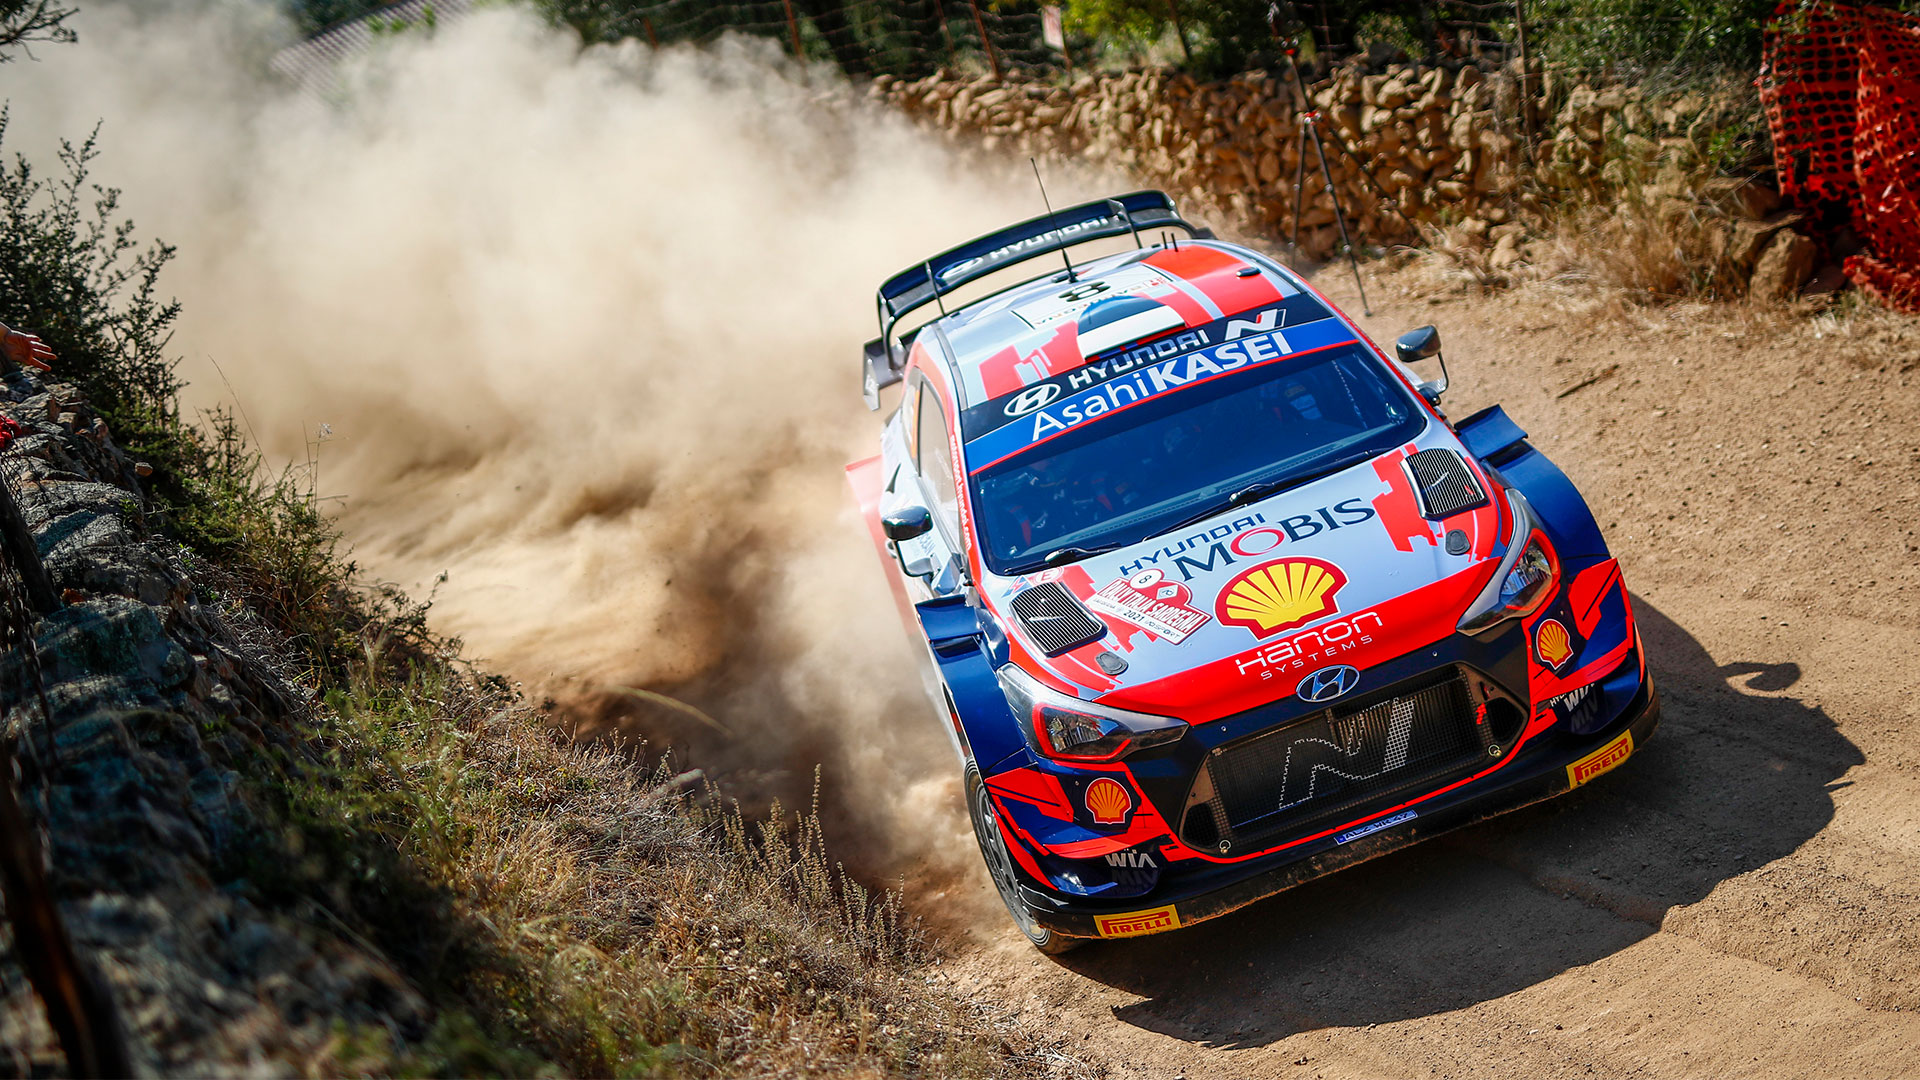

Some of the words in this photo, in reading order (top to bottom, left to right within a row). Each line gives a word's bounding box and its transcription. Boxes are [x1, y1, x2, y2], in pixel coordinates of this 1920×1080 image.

[989, 215, 1109, 259] HYUNDAI
[1058, 281, 1111, 302] 8
[1068, 329, 1211, 390] HYUNDAI
[1119, 513, 1267, 576] HYUNDAI
[1172, 498, 1376, 582] MOBIS
[1139, 574, 1152, 584] 8
[1100, 580, 1134, 603] RALLY
[1122, 588, 1153, 613] ITALIA
[1147, 601, 1206, 634] SARDEGNA
[1123, 609, 1145, 623] 2021
[1260, 635, 1373, 680] SYSTEMS
[1573, 737, 1630, 782] PIRELLI
[1100, 911, 1172, 935] PIRELLI
